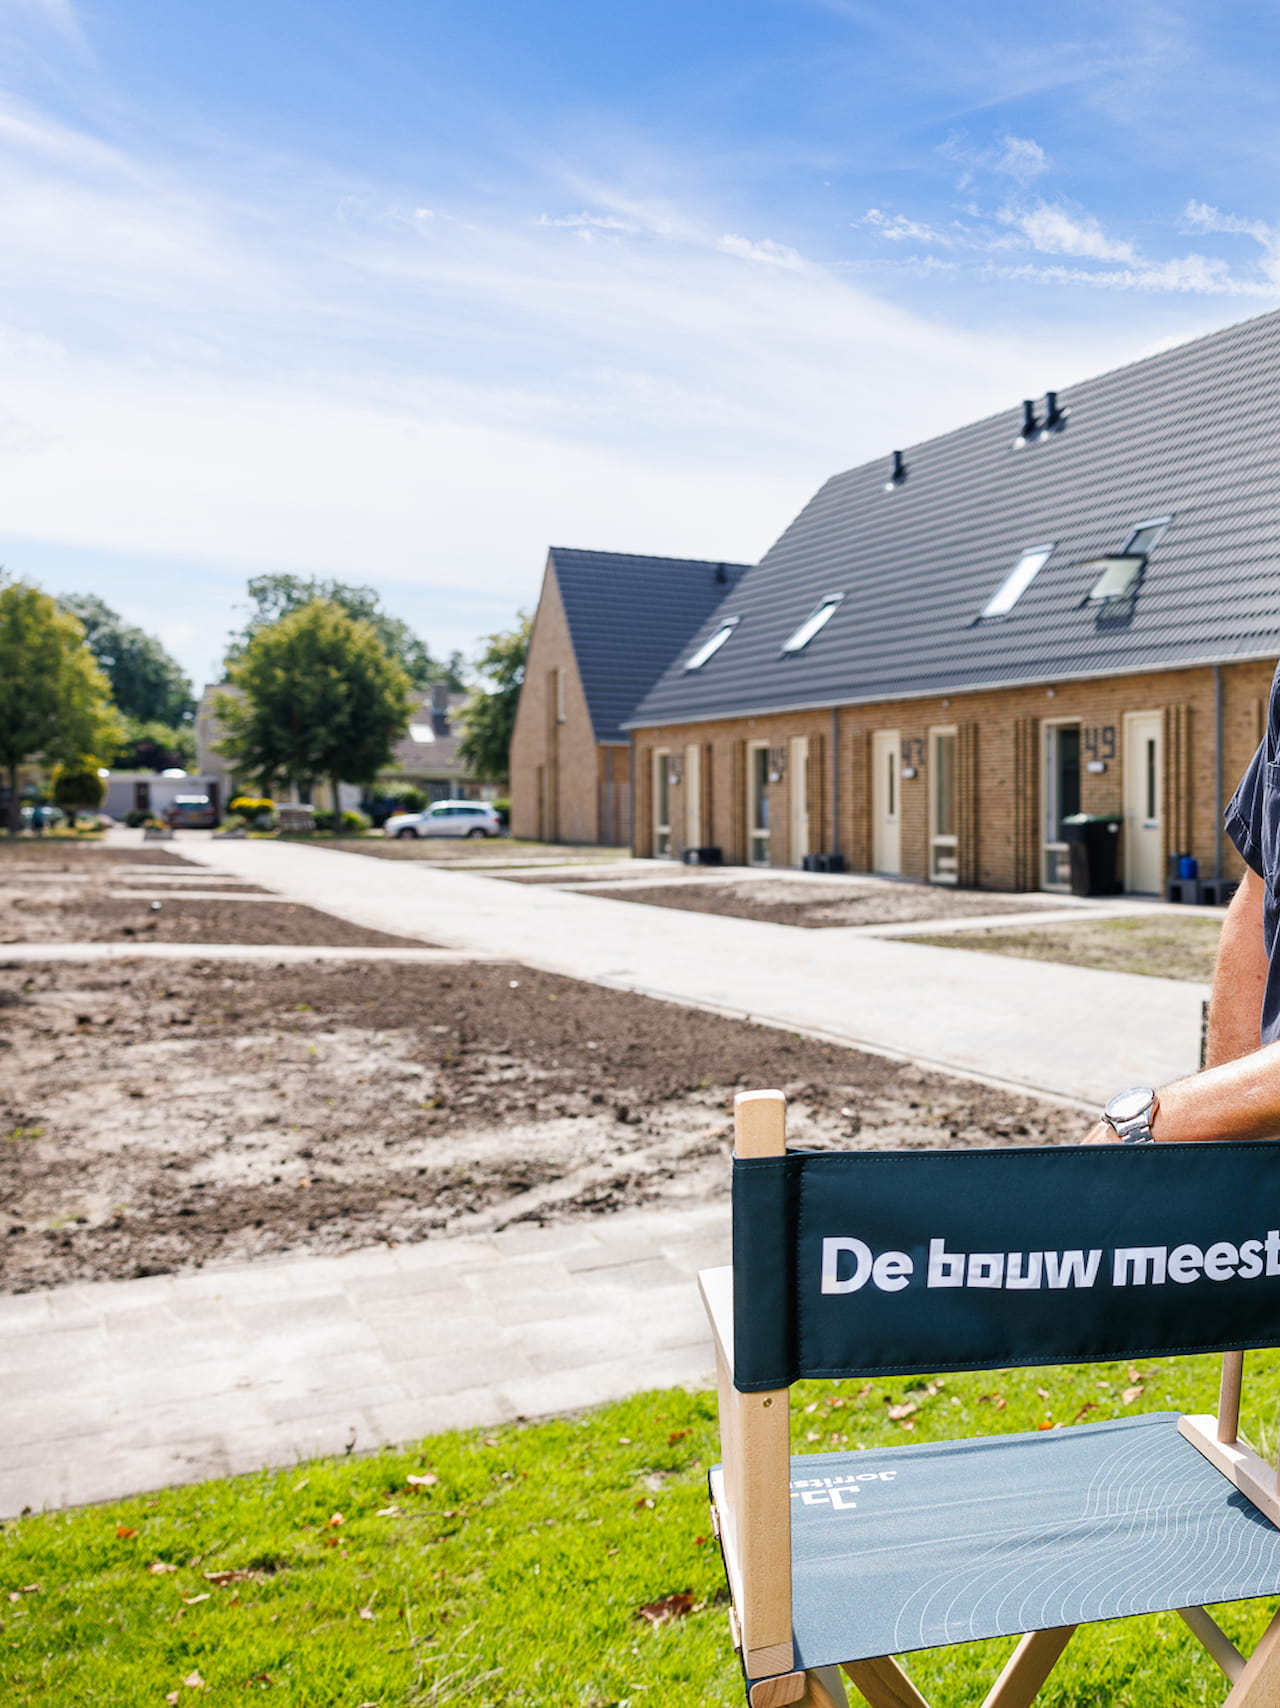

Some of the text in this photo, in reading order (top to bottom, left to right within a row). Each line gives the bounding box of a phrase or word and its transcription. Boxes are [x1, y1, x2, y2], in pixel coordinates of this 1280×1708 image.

[1085, 726, 1116, 761] 49
[820, 1236, 914, 1295] De
[926, 1238, 1103, 1290] bouw
[789, 1470, 897, 1489] Jorrits
